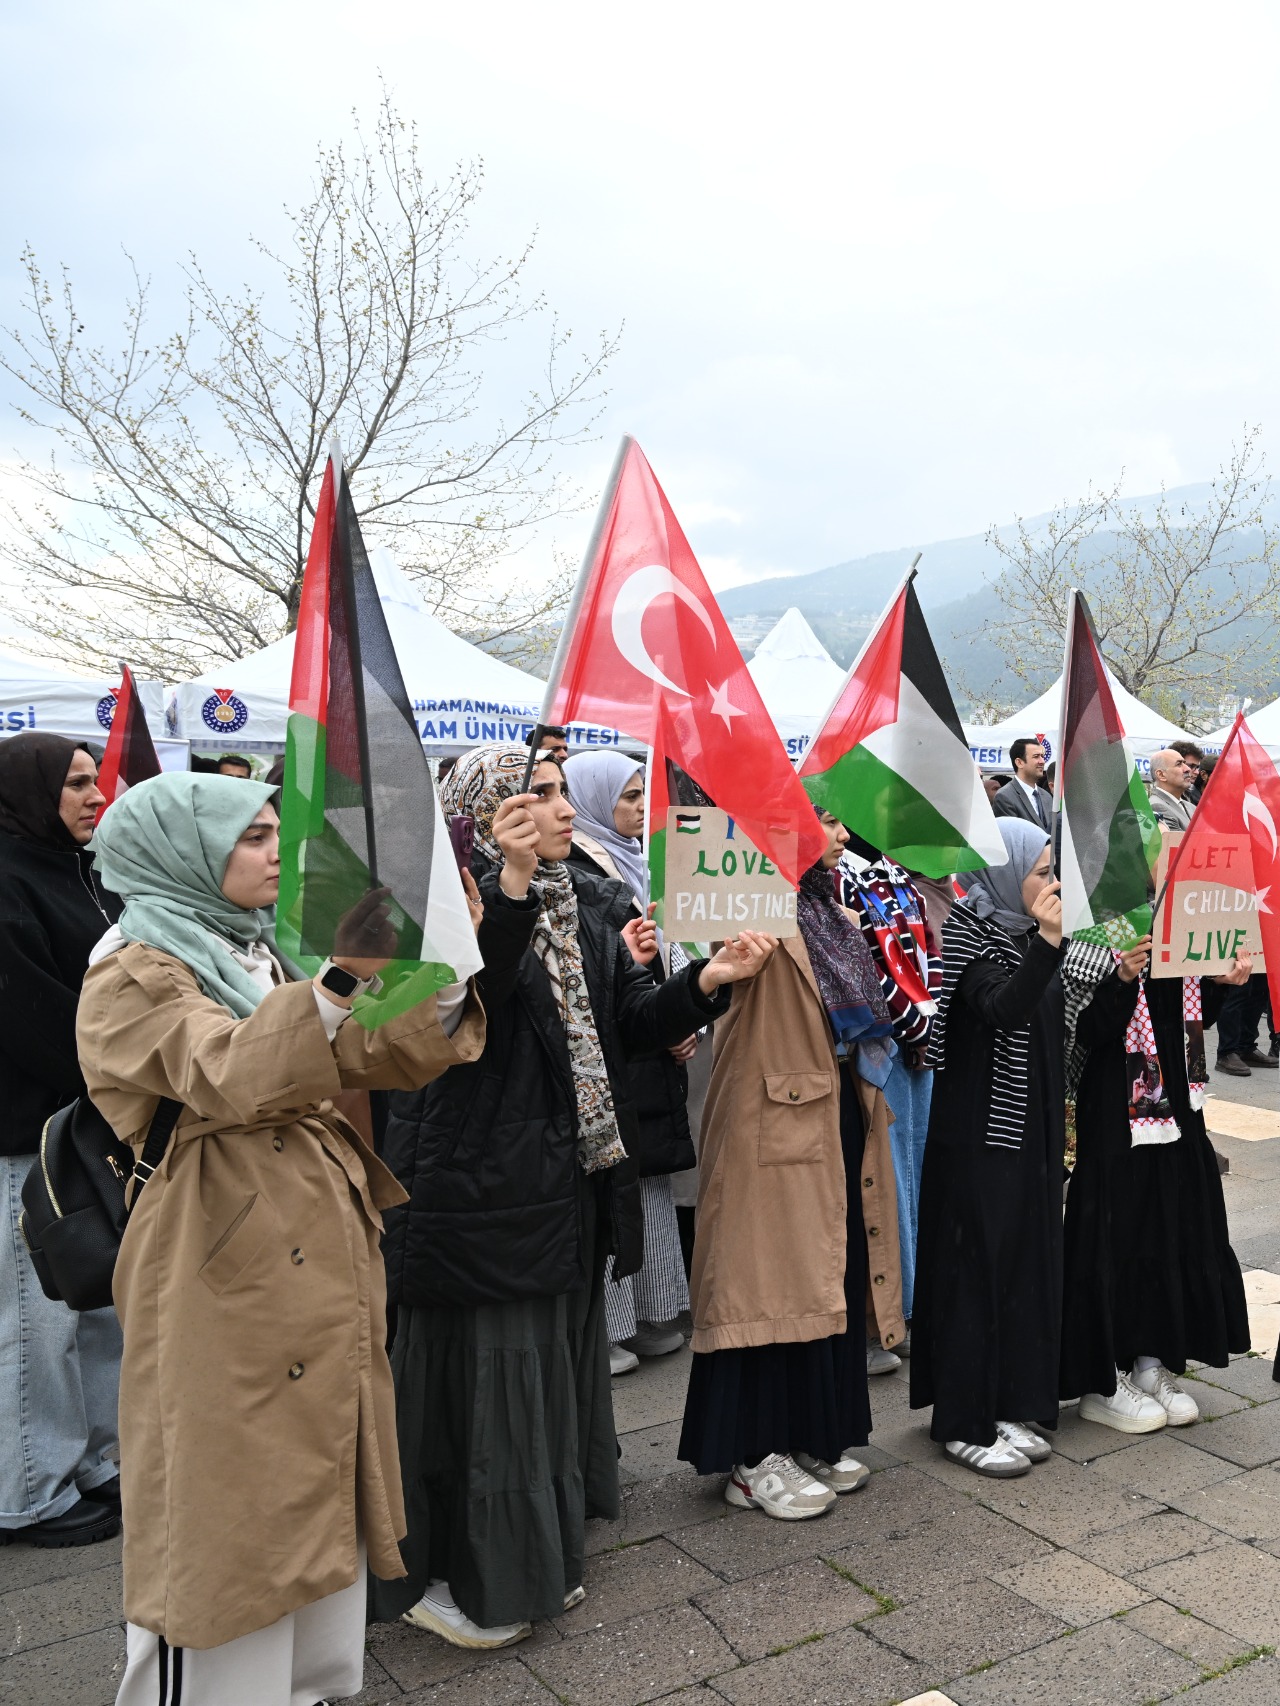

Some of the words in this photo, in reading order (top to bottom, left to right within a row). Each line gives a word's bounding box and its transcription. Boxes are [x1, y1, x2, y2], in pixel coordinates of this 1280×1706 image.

[692, 850, 776, 877] LOVE
[1187, 846, 1239, 869] LET
[676, 891, 798, 922] PALISTINE
